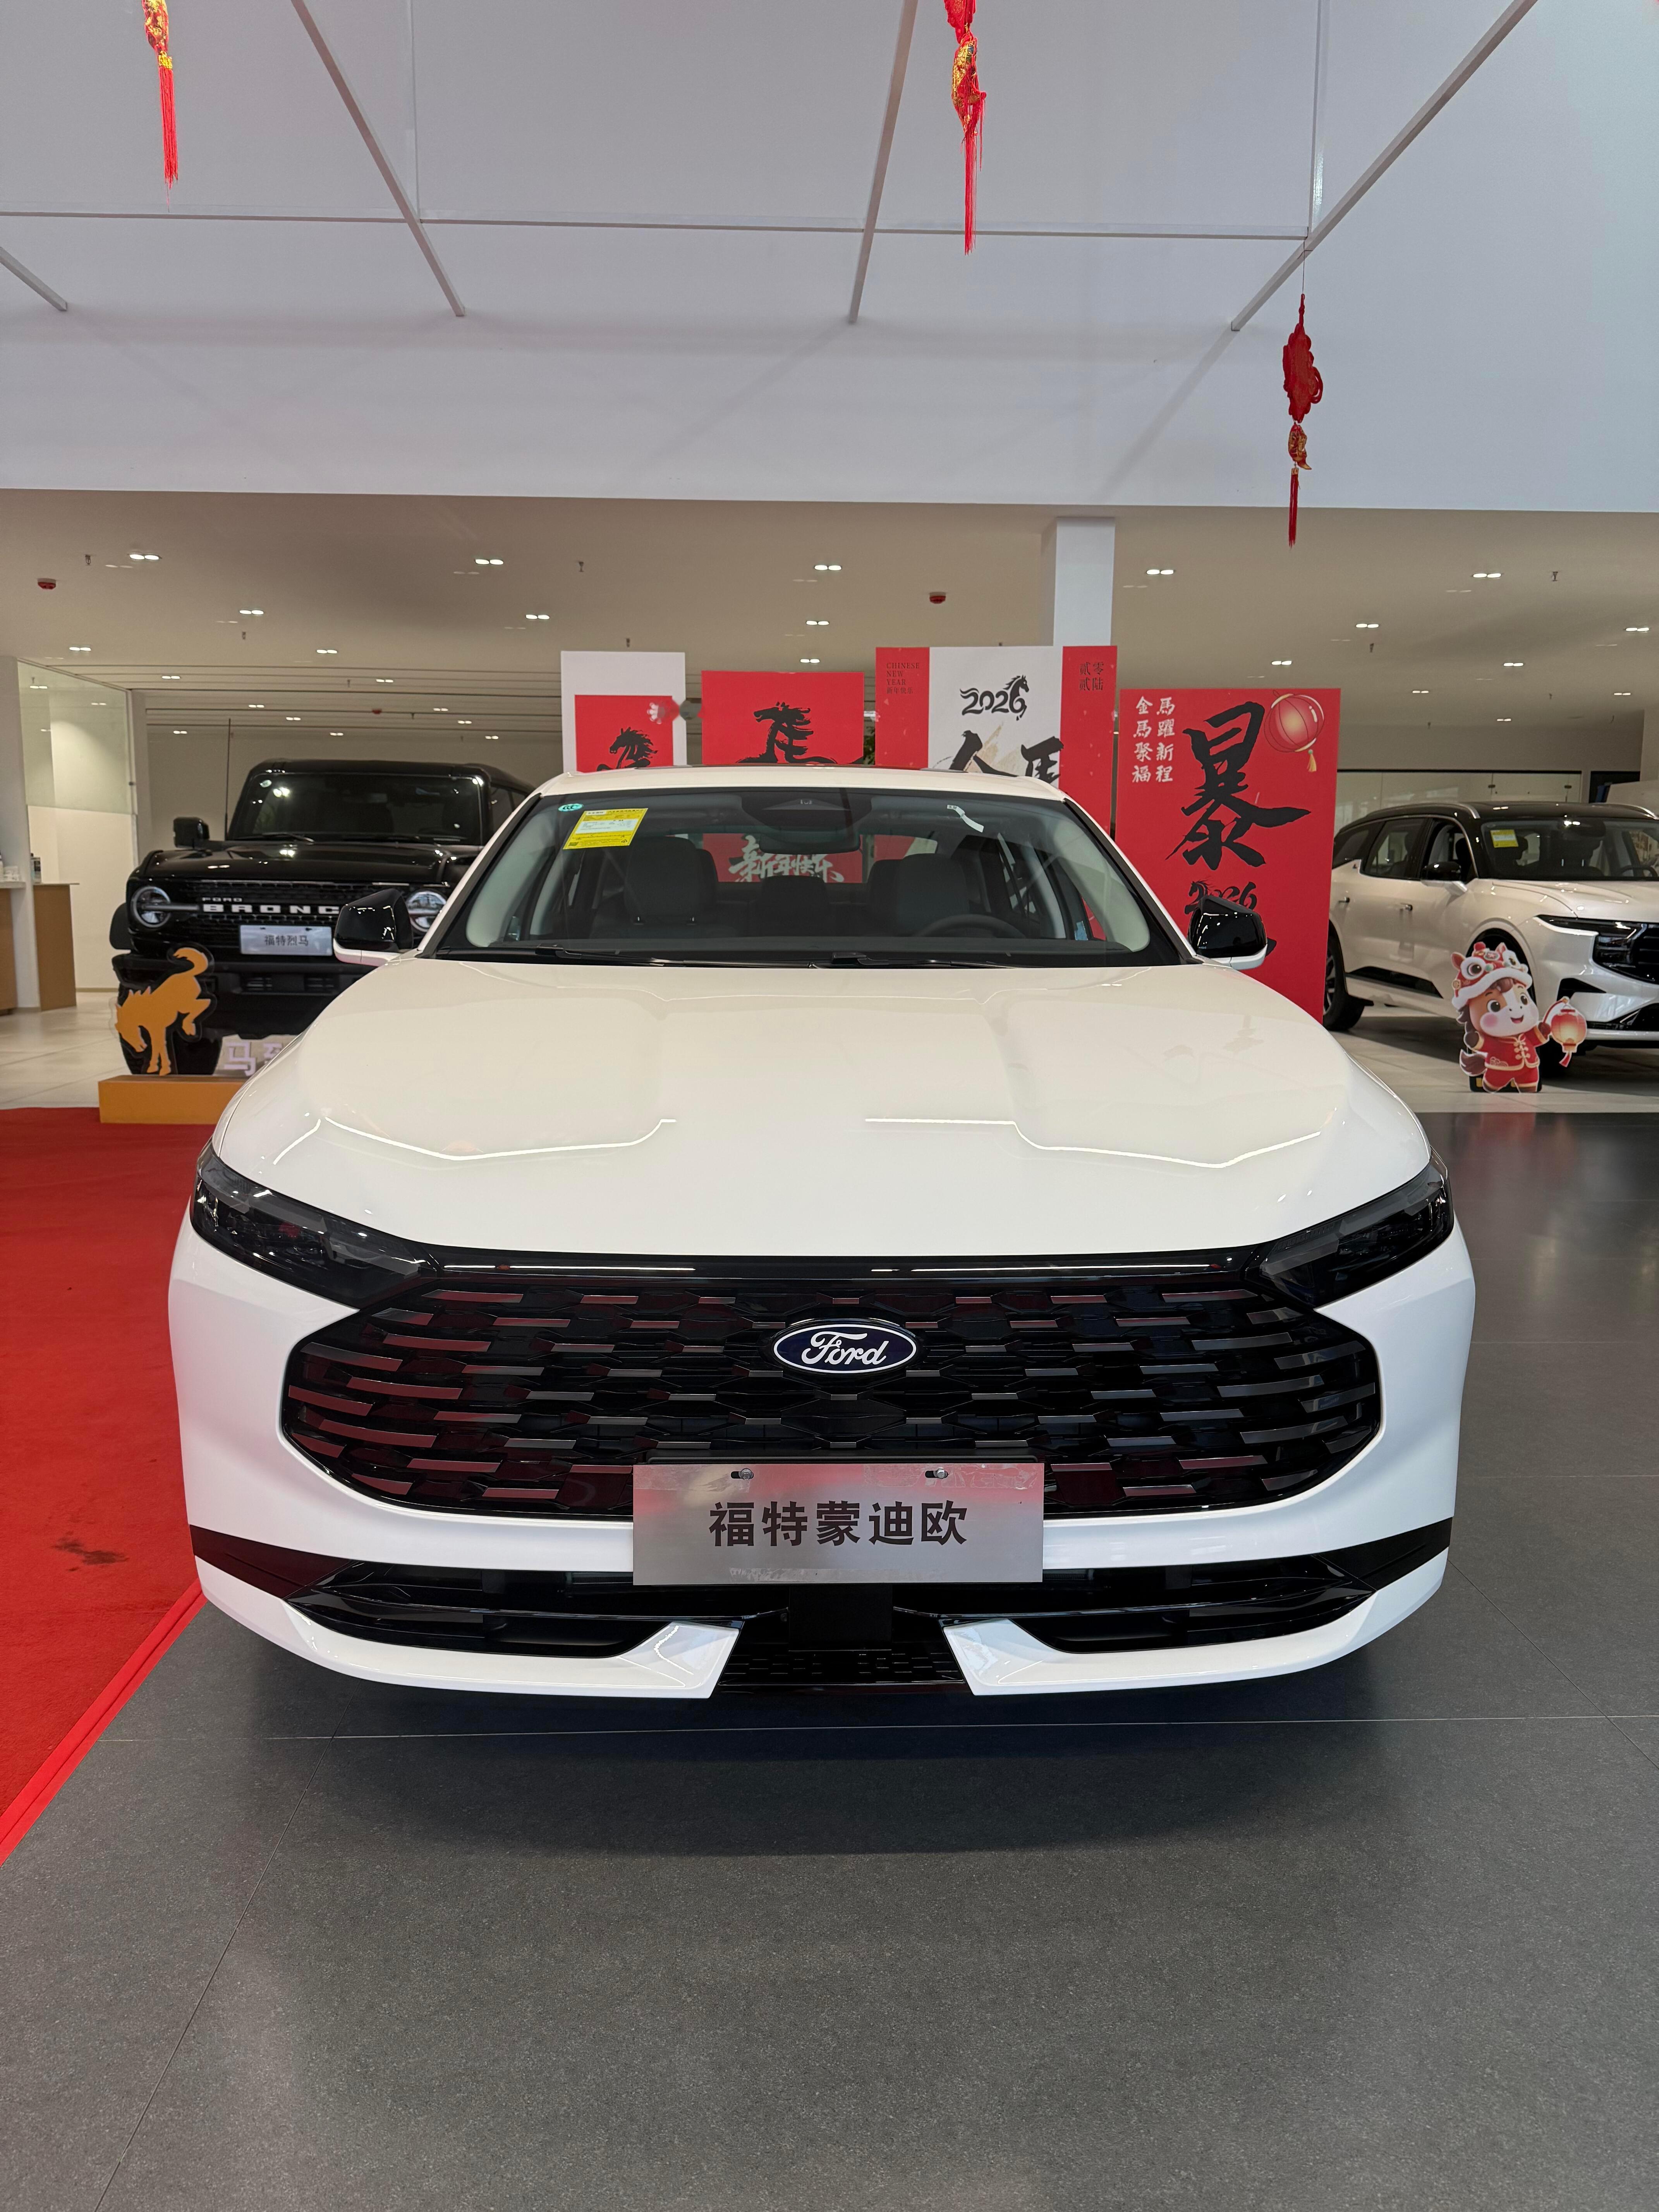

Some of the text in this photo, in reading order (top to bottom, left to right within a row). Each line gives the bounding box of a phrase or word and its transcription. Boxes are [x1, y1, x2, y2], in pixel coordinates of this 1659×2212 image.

[959, 674, 1029, 721] 2026
[1132, 696, 1153, 783] 金馬聚福
[203, 903, 340, 915] BRONC
[264, 934, 309, 947] 福特烈马
[801, 1331, 889, 1366] Ford
[708, 1500, 968, 1547] 福特蒙迪欧
